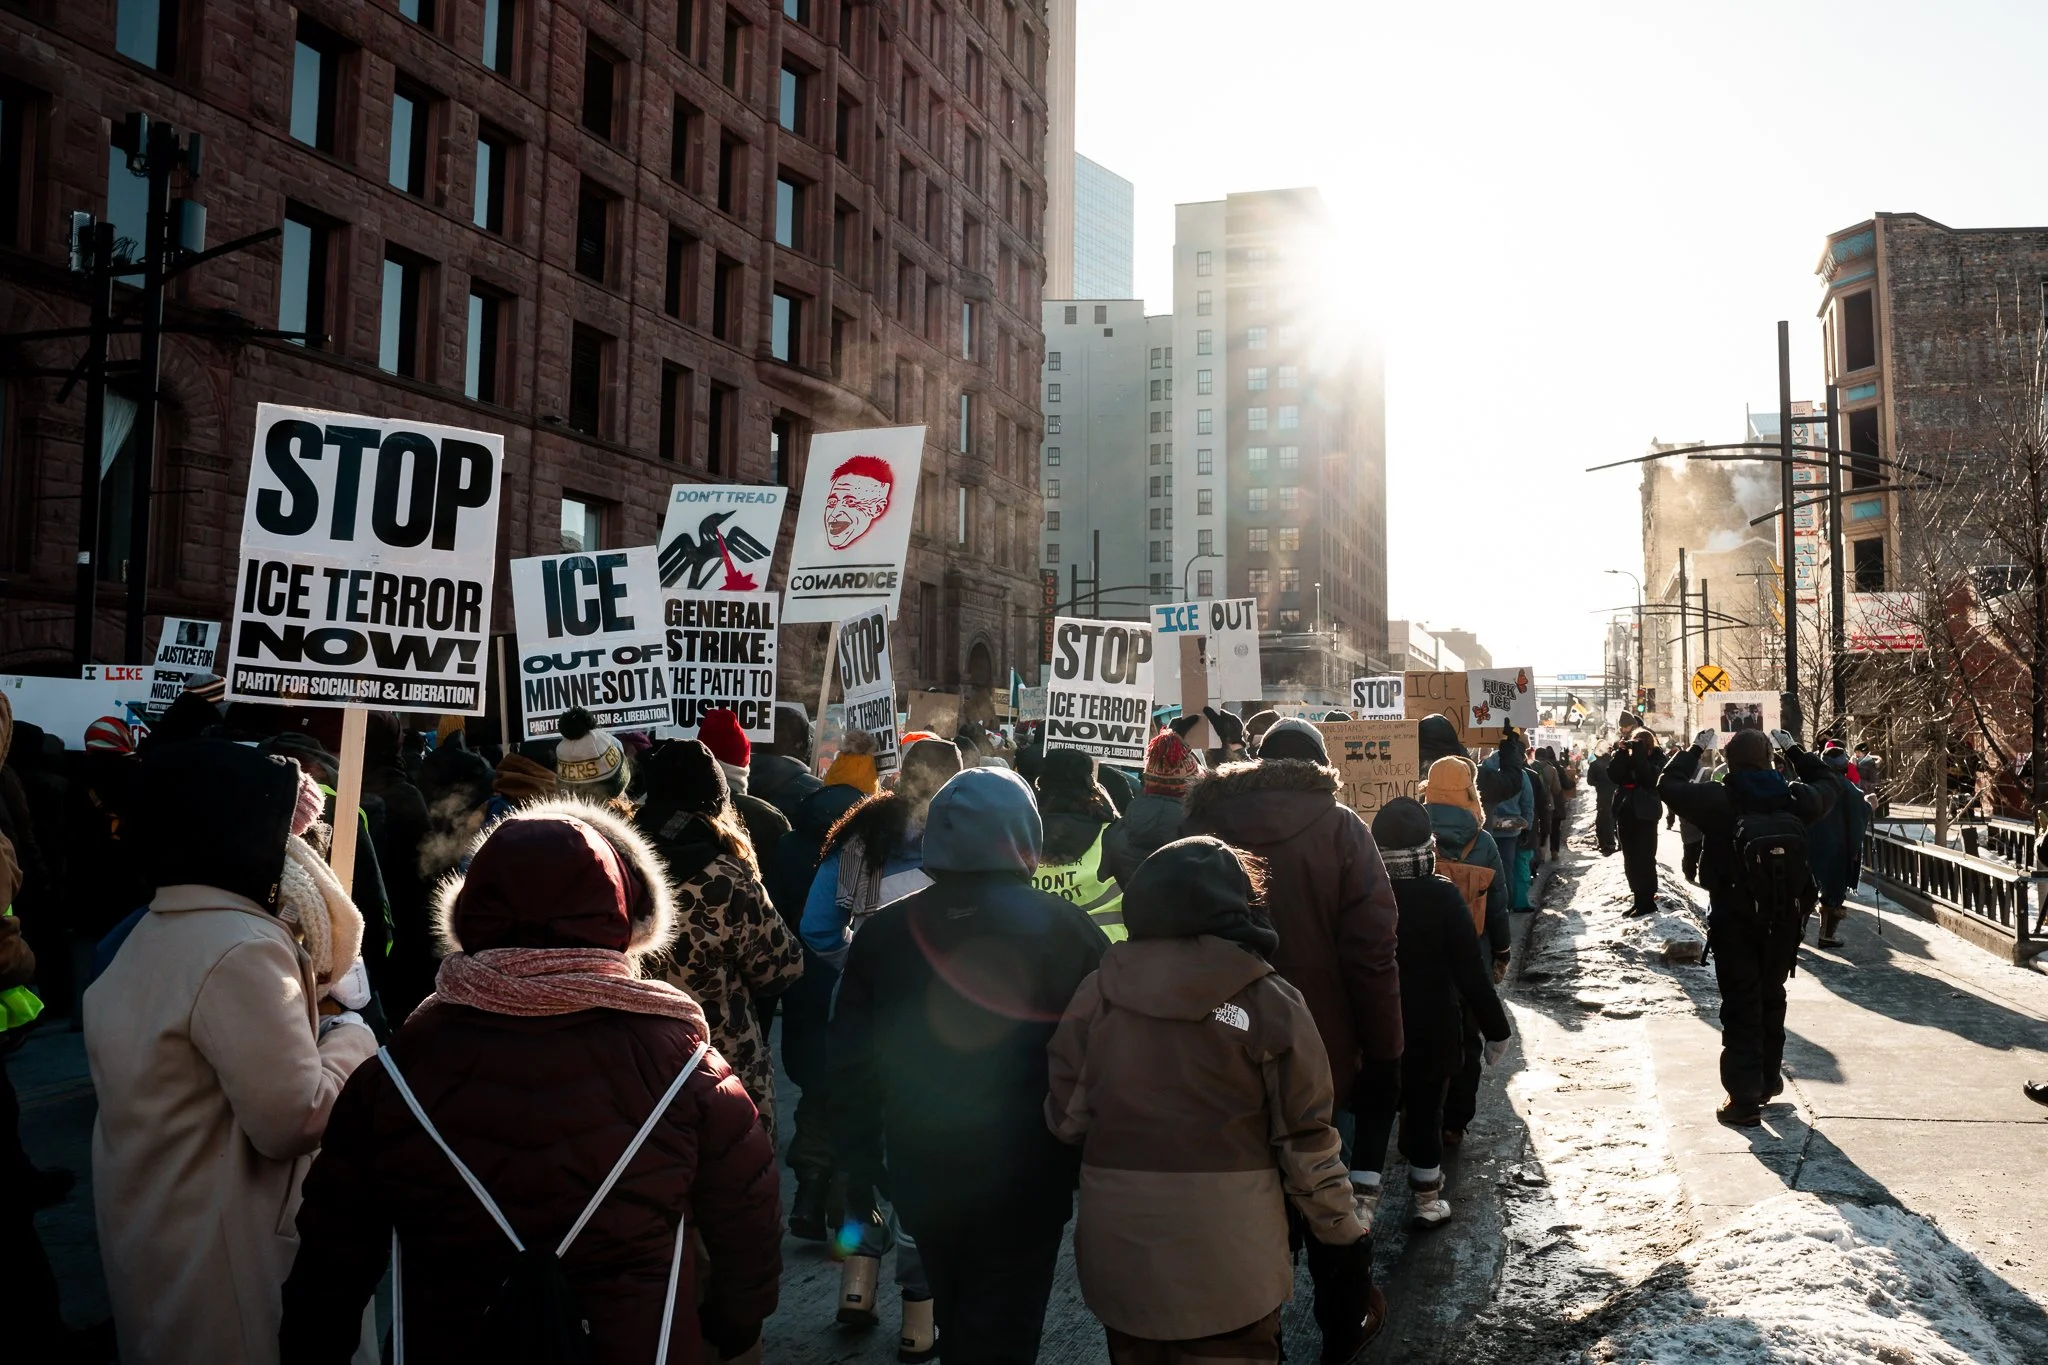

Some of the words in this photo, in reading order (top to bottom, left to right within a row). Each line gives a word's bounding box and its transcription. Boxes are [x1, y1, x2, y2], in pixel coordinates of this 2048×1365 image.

[255, 419, 494, 551] STOP
[675, 490, 725, 504] DON'T
[726, 491, 778, 505] TREAD
[790, 572, 898, 591] COWARDICE
[242, 559, 314, 619] ICE
[323, 567, 483, 633] TERROR
[542, 553, 635, 638] ICE
[664, 598, 774, 630] GENERAL
[1156, 605, 1199, 632] ICE
[1212, 601, 1253, 630] OUT
[159, 646, 198, 666] JUSTICE
[199, 650, 213, 667] FOR
[237, 620, 481, 675] NOW!
[523, 648, 606, 674] OUT
[612, 644, 663, 665] OF
[666, 629, 773, 664] STRIKE:
[840, 613, 885, 690] STOP
[1054, 623, 1152, 684] STOP
[84, 667, 96, 680] I
[105, 667, 143, 681] LIKE
[154, 670, 190, 682] REN
[237, 670, 282, 691] PARTY
[282, 674, 309, 695] FOR
[310, 677, 380, 699] SOCIALISM
[382, 682, 399, 700] &
[402, 684, 475, 705] LIBERATION
[700, 668, 745, 697] PATH
[749, 670, 773, 698] TO
[1408, 672, 1456, 700] ICE
[1696, 680, 1703, 689] R
[151, 683, 181, 700] NICOLE
[525, 667, 667, 712] MINNESOTA
[1353, 680, 1402, 708] STOP
[1482, 677, 1516, 700] FUCK
[846, 704, 858, 733] ICE
[858, 697, 891, 731] TERROR
[1049, 691, 1076, 718] ICE
[1079, 694, 1147, 725] TERROR
[1309, 712, 1326, 721] ar
[1489, 694, 1511, 712] ICE
[530, 717, 555, 733] PARTY
[612, 713, 624, 724] &
[624, 707, 667, 722] LIBERATION
[1047, 719, 1146, 744] NOW!
[1047, 740, 1064, 750] PARTY
[1075, 743, 1104, 755] SOCIALISM
[1104, 746, 1111, 756] &
[1111, 747, 1143, 758] LIBERATION
[1344, 740, 1391, 763] ICE
[1340, 760, 1351, 776] IS
[1372, 760, 1414, 776] UNDER
[1344, 779, 1419, 808] ISTANCE
[1212, 1007, 1238, 1018] ORTH
[1215, 1013, 1236, 1026] FACE
[1223, 1002, 1239, 1012] THE
